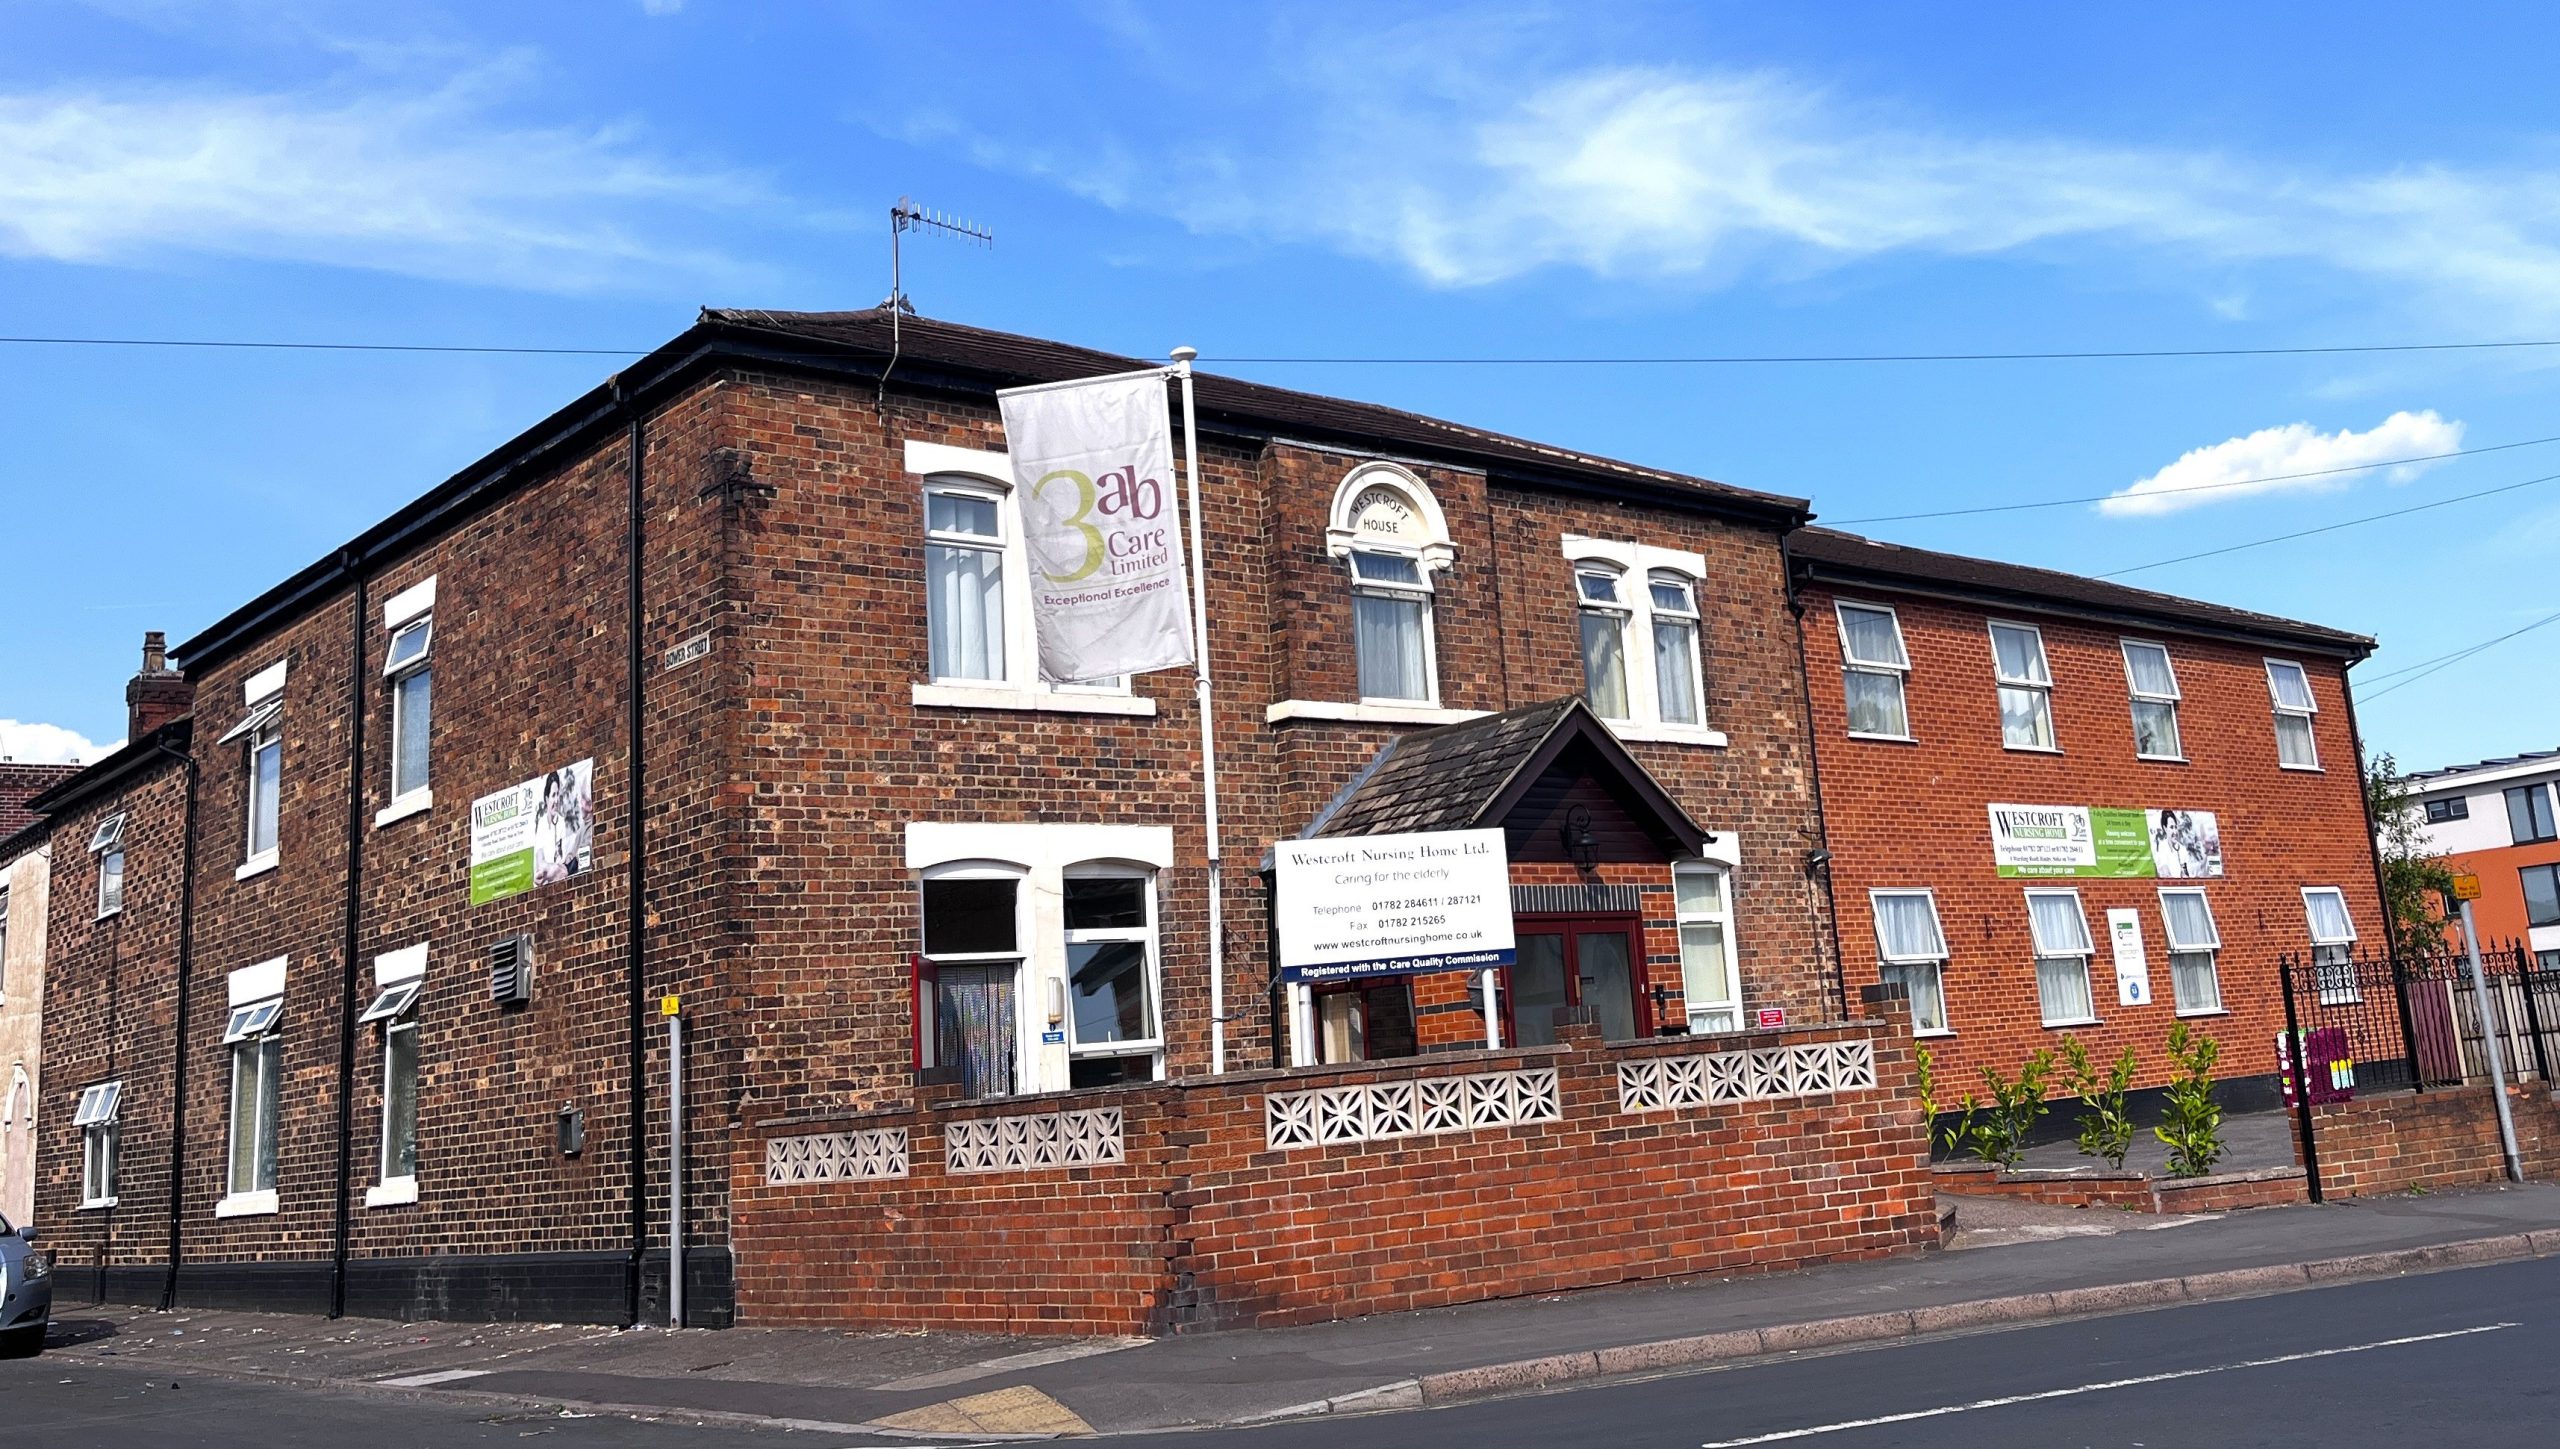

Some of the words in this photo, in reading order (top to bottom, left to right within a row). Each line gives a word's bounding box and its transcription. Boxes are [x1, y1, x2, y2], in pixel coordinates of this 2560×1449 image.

[1351, 493, 1409, 521] WESTCROFT
[1363, 518, 1399, 533] HOUSE
[1108, 528, 1165, 558] Care
[1111, 547, 1168, 576] Limited
[1043, 589, 1112, 606] Exceptional
[1114, 578, 1170, 596] Excellence
[666, 648, 685, 668] BOWER
[687, 638, 707, 658] STREET
[475, 791, 518, 829] WESTCROFT
[1995, 811, 2064, 839] WESTCROFT
[2014, 827, 2044, 838] NURSING
[2044, 828, 2065, 839] HOME
[1291, 851, 1355, 866] Westcroft
[1362, 848, 1414, 861] Nursing
[1420, 845, 1458, 858] Home
[1463, 842, 1489, 855] Ltd.
[1334, 874, 1372, 886] Caring
[1374, 871, 1389, 882] for
[1392, 870, 1411, 881] the
[1413, 867, 1450, 881] elderly
[1313, 904, 1362, 916] Telephone
[1372, 900, 1401, 911] 01782
[1404, 898, 1438, 909] 284611
[1447, 894, 1481, 906] 287121
[1350, 921, 1368, 931] Fax
[1378, 917, 1408, 928] 01782
[1410, 914, 1446, 926] 215265
[1313, 929, 1483, 951] www.westcroftnursinghome.co.uk
[1301, 964, 1350, 978] Registered
[1351, 963, 1371, 973] with
[1372, 961, 1387, 971] the
[1390, 960, 1411, 970] Care
[1412, 957, 1444, 968] Quality
[1445, 953, 1500, 965] Commission
